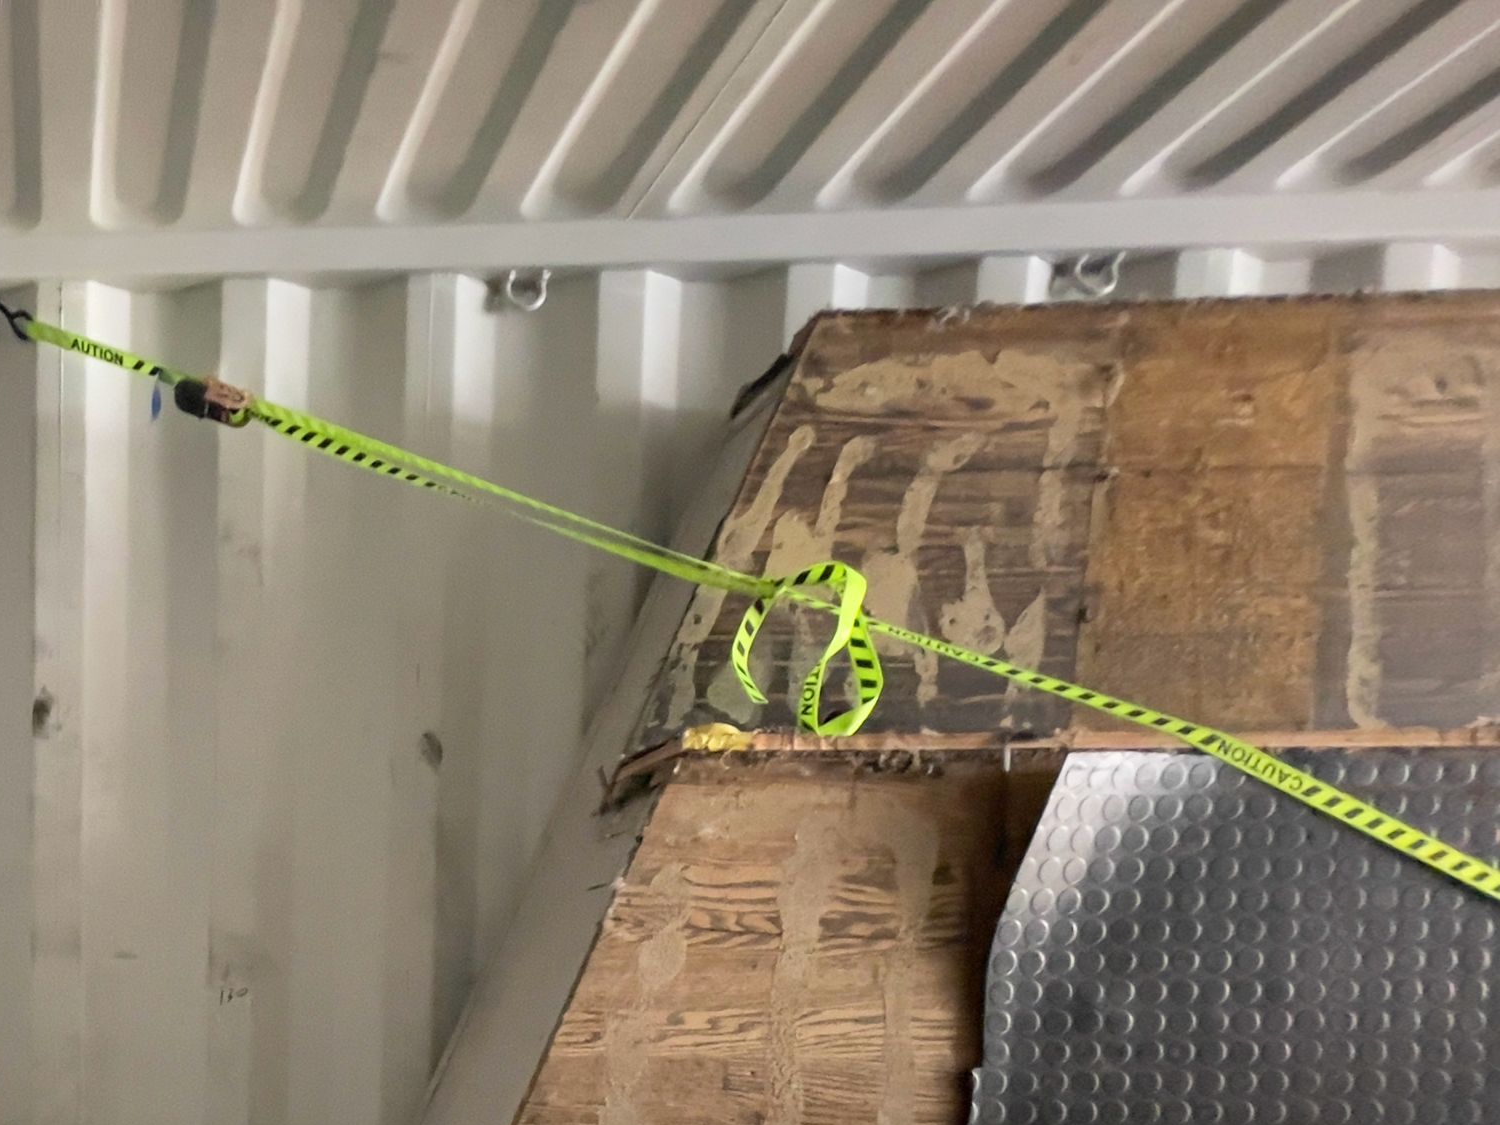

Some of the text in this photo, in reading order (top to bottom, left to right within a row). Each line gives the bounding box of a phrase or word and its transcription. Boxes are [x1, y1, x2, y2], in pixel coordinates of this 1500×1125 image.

[889, 628, 980, 664] CAUTION
[801, 664, 821, 716] TION
[1217, 739, 1304, 791] CAUTION
